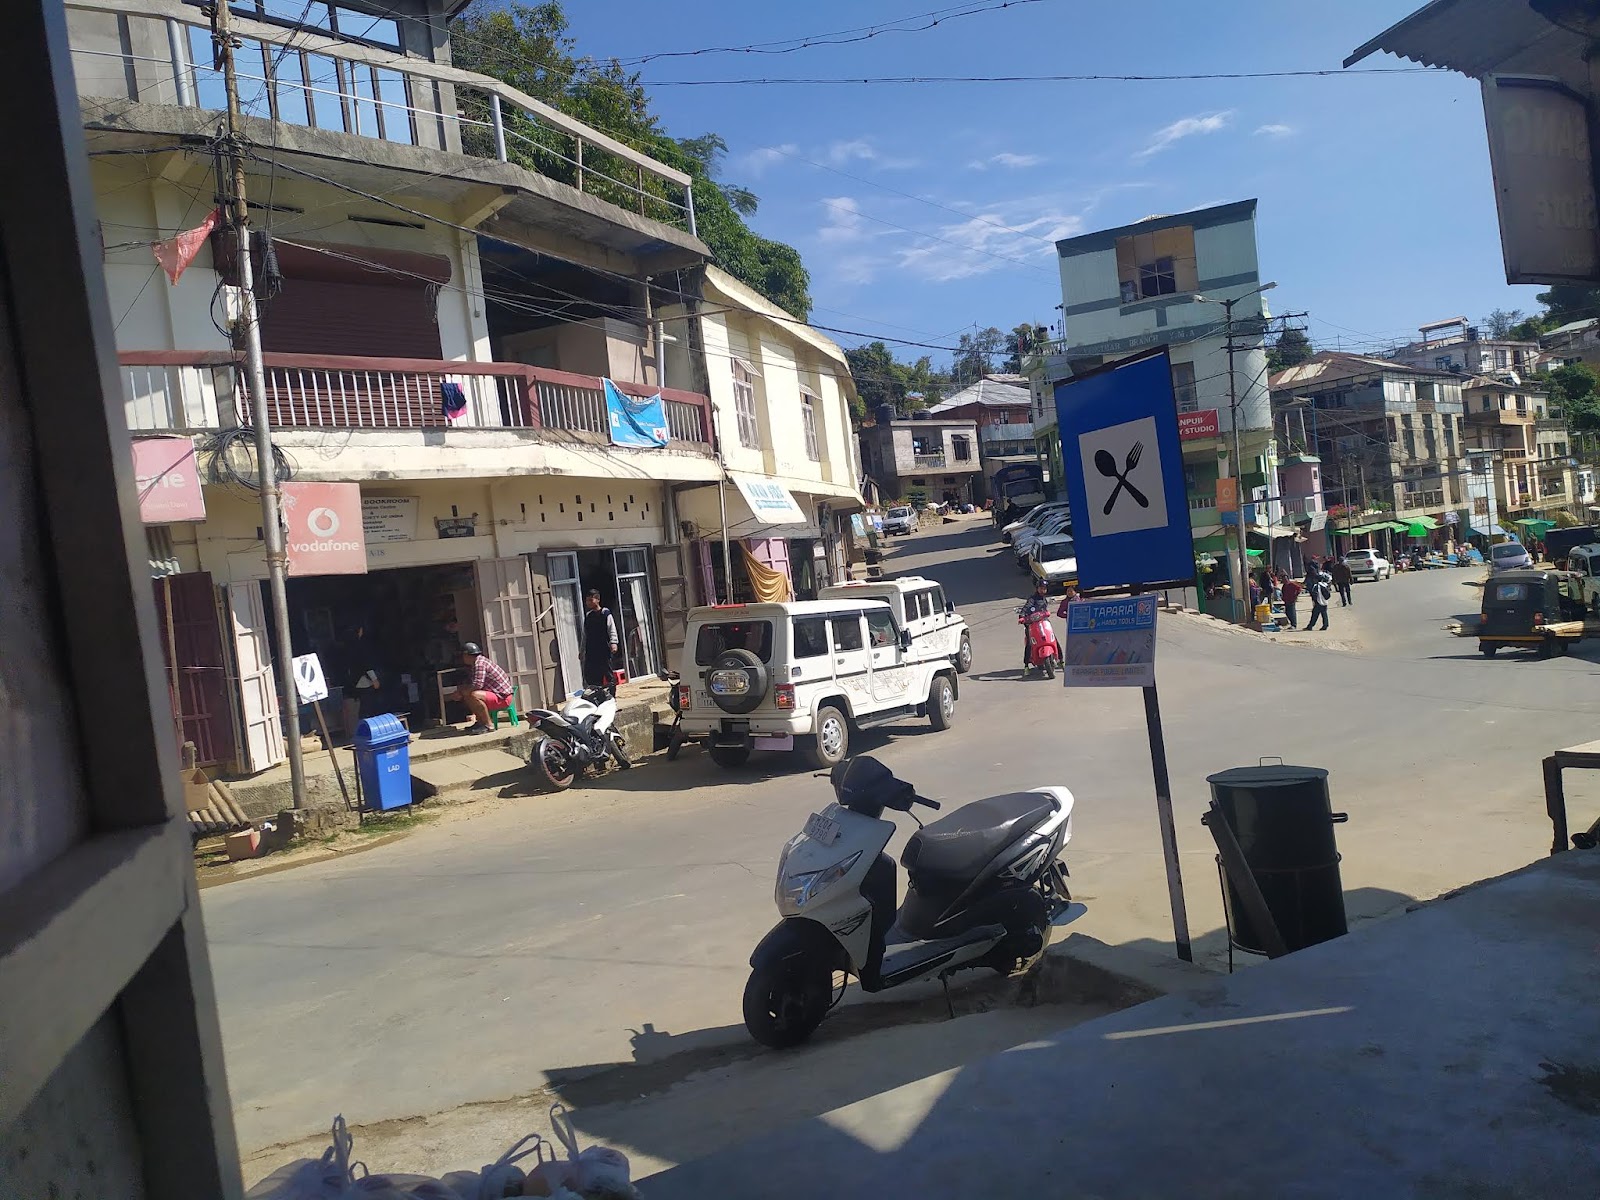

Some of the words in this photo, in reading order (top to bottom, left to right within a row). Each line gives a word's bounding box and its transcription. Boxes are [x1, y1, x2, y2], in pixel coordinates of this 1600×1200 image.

[1129, 334, 1159, 347] BRANCH
[1185, 424, 1215, 435] STUDIO
[291, 540, 360, 553] vodafone
[1093, 604, 1134, 618] TAPARIA
[1101, 618, 1117, 627] HAND
[1119, 617, 1136, 626] TOOLS
